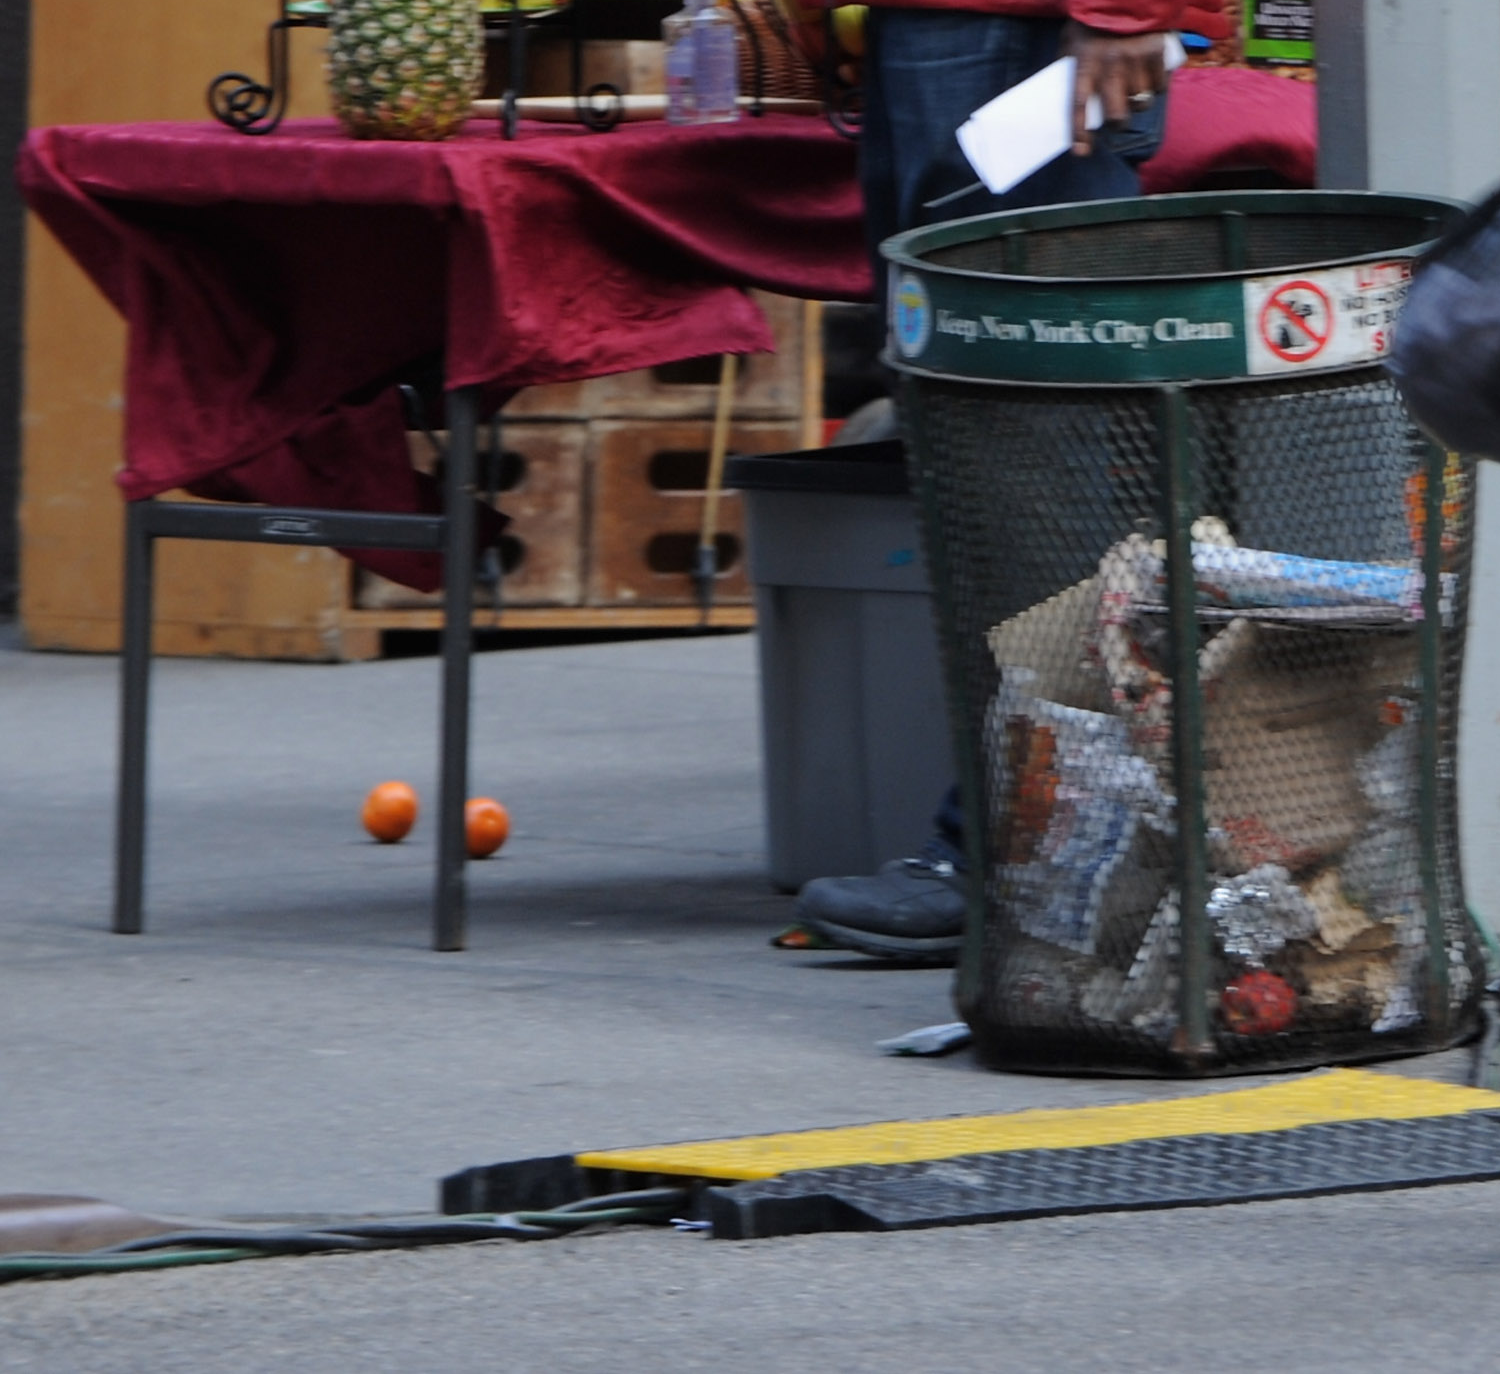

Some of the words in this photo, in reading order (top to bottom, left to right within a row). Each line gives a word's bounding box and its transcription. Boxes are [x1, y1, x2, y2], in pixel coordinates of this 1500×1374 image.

[980, 315, 1029, 341] New
[1028, 319, 1094, 343] York
[1092, 319, 1151, 349] City
[1153, 317, 1235, 342] Clean
